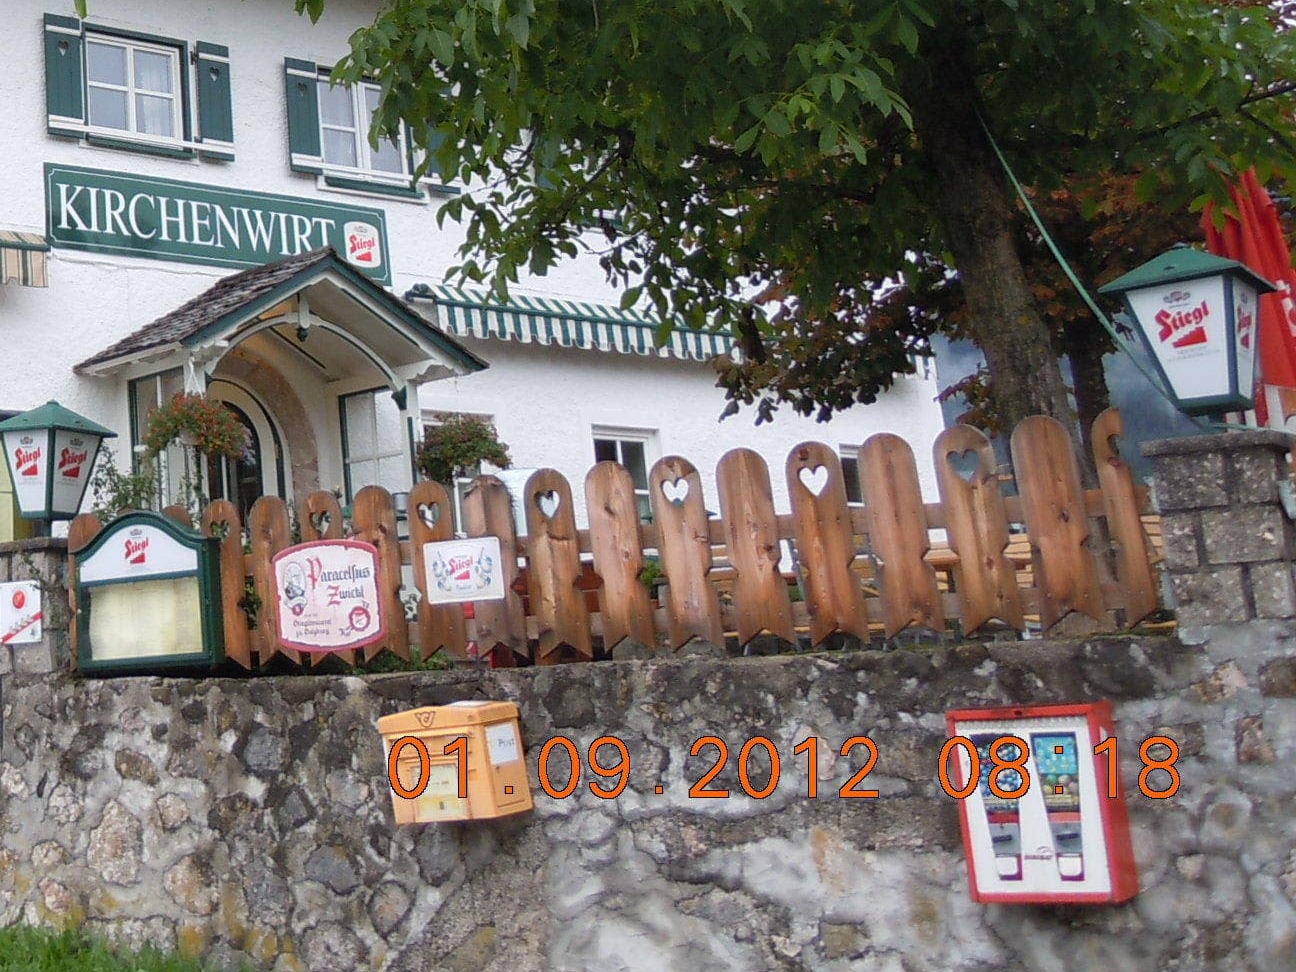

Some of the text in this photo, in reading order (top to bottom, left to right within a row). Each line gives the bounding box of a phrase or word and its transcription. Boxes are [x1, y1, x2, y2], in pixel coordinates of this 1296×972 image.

[55, 183, 335, 255] KIRCHENWIRT
[349, 235, 375, 254] Stiegl
[1155, 300, 1211, 343] Stiegl
[15, 447, 42, 470] Stiegl
[58, 447, 88, 469] Stiegl
[124, 537, 149, 559] Stiegl
[449, 557, 474, 575] Stiegl
[327, 585, 364, 607] Zwickl
